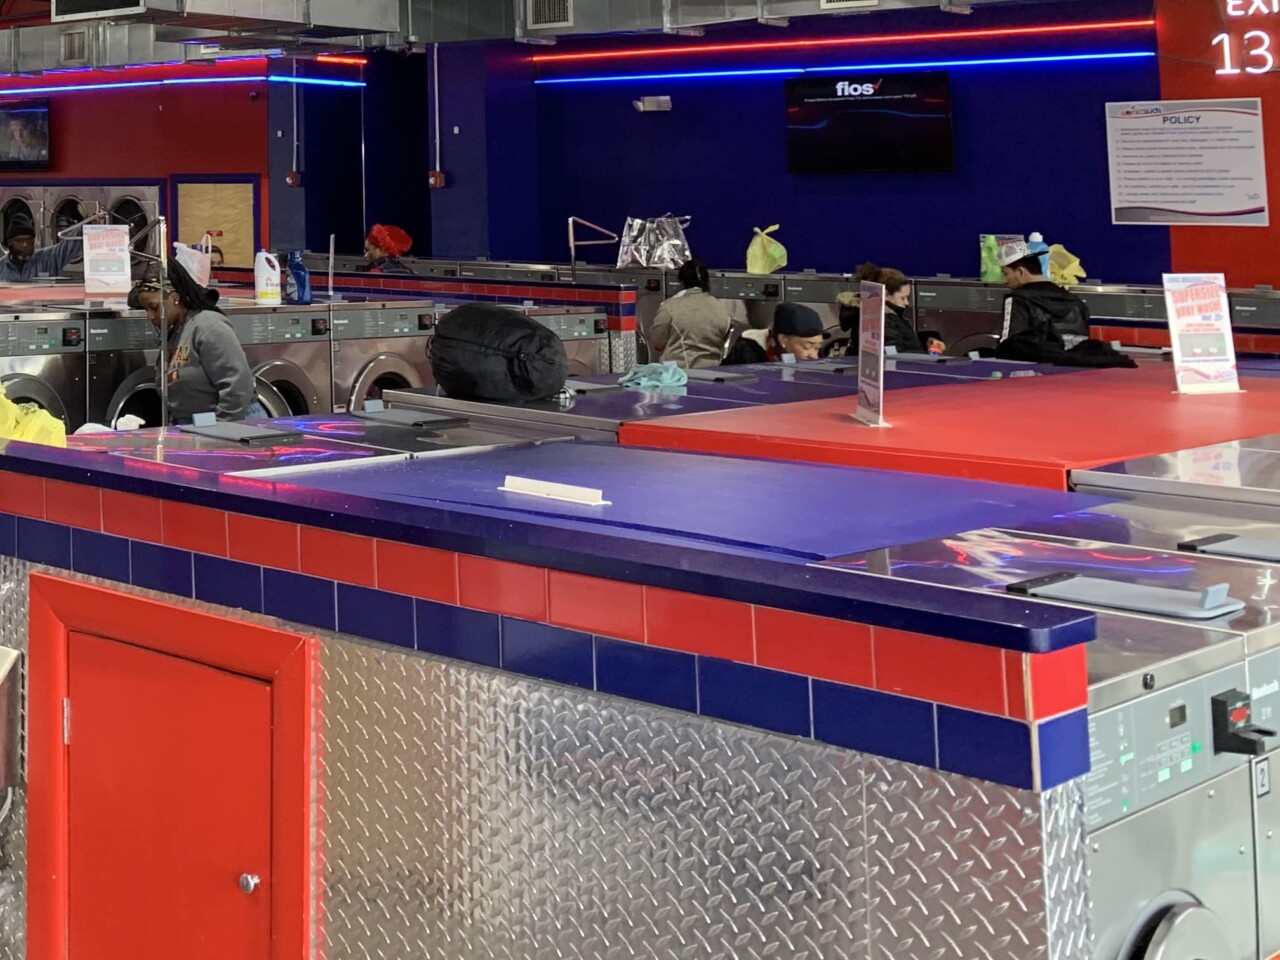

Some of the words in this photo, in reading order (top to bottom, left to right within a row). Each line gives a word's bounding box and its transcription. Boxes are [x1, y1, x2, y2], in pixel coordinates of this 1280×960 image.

[1211, 30, 1274, 75] 13
[835, 81, 874, 96] fios
[1162, 116, 1201, 125] POLICY
[1170, 285, 1221, 304] SUPERSIZE
